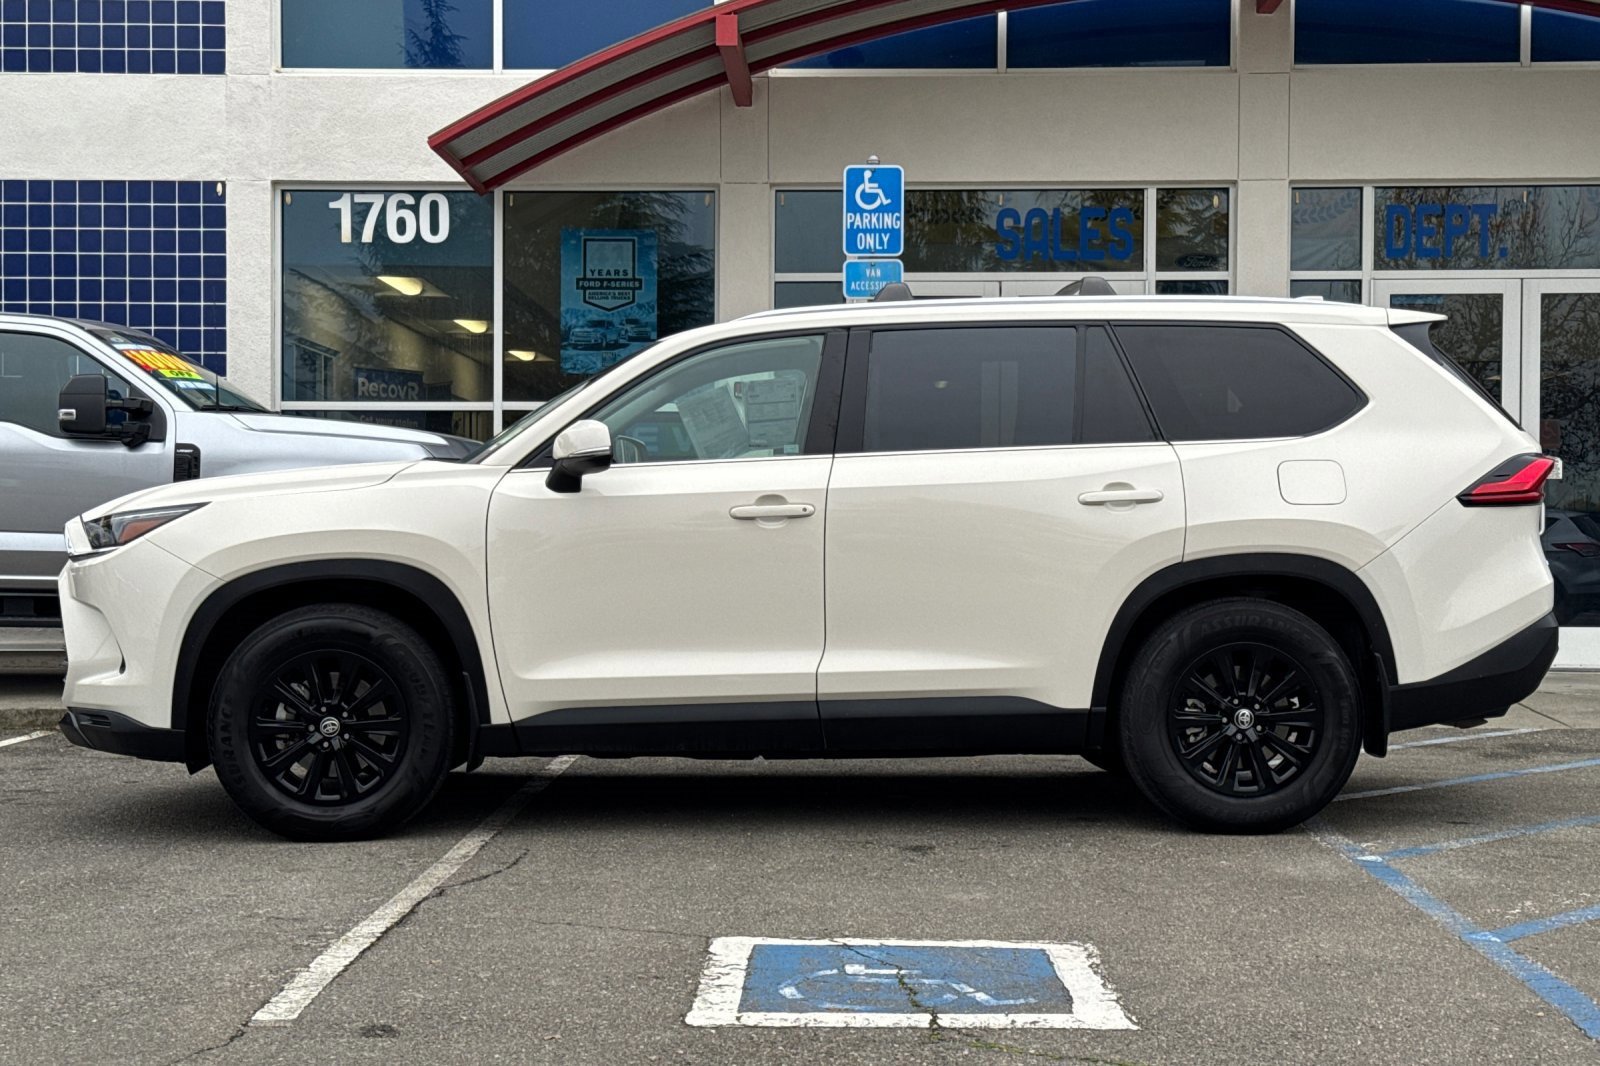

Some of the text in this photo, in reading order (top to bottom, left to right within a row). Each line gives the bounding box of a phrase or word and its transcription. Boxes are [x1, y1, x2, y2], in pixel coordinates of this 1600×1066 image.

[328, 193, 450, 244] 1760
[847, 212, 901, 230] PARKING
[857, 232, 890, 250] ONLY
[997, 203, 1509, 262] SALES DEPT.
[589, 268, 629, 277] YEARS
[865, 268, 881, 278] VAN
[579, 280, 640, 288] FORD F-SERIES
[357, 377, 420, 400] RecovR
